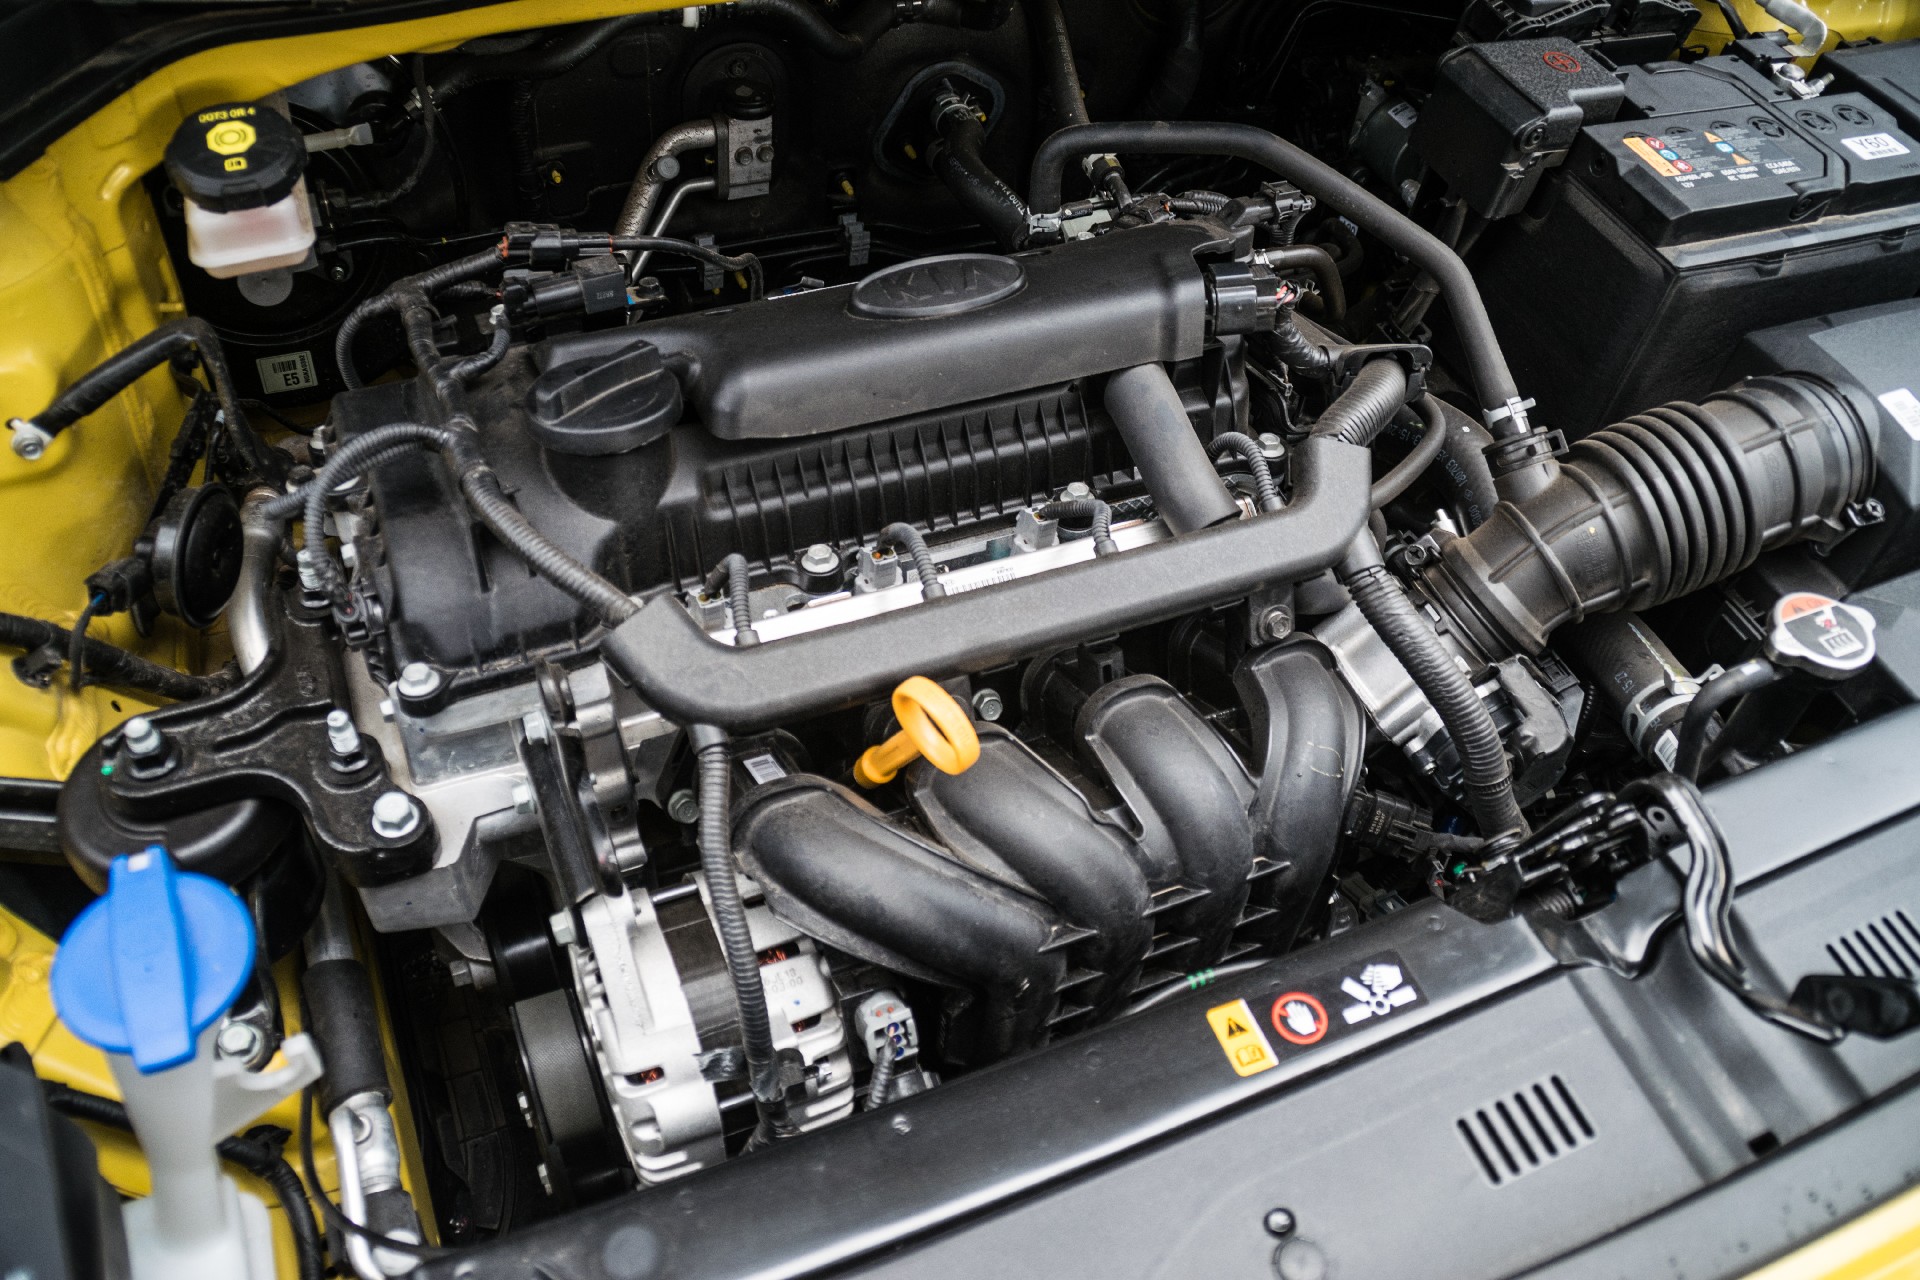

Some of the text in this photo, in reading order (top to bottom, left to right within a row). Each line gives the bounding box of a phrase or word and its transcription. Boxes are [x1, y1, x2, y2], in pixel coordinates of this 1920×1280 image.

[198, 106, 256, 123] DOT3 OR 4
[1851, 136, 1889, 150] Y60
[877, 258, 1008, 301] KIA
[283, 372, 300, 387] E5
[1445, 459, 1468, 487] 180703
